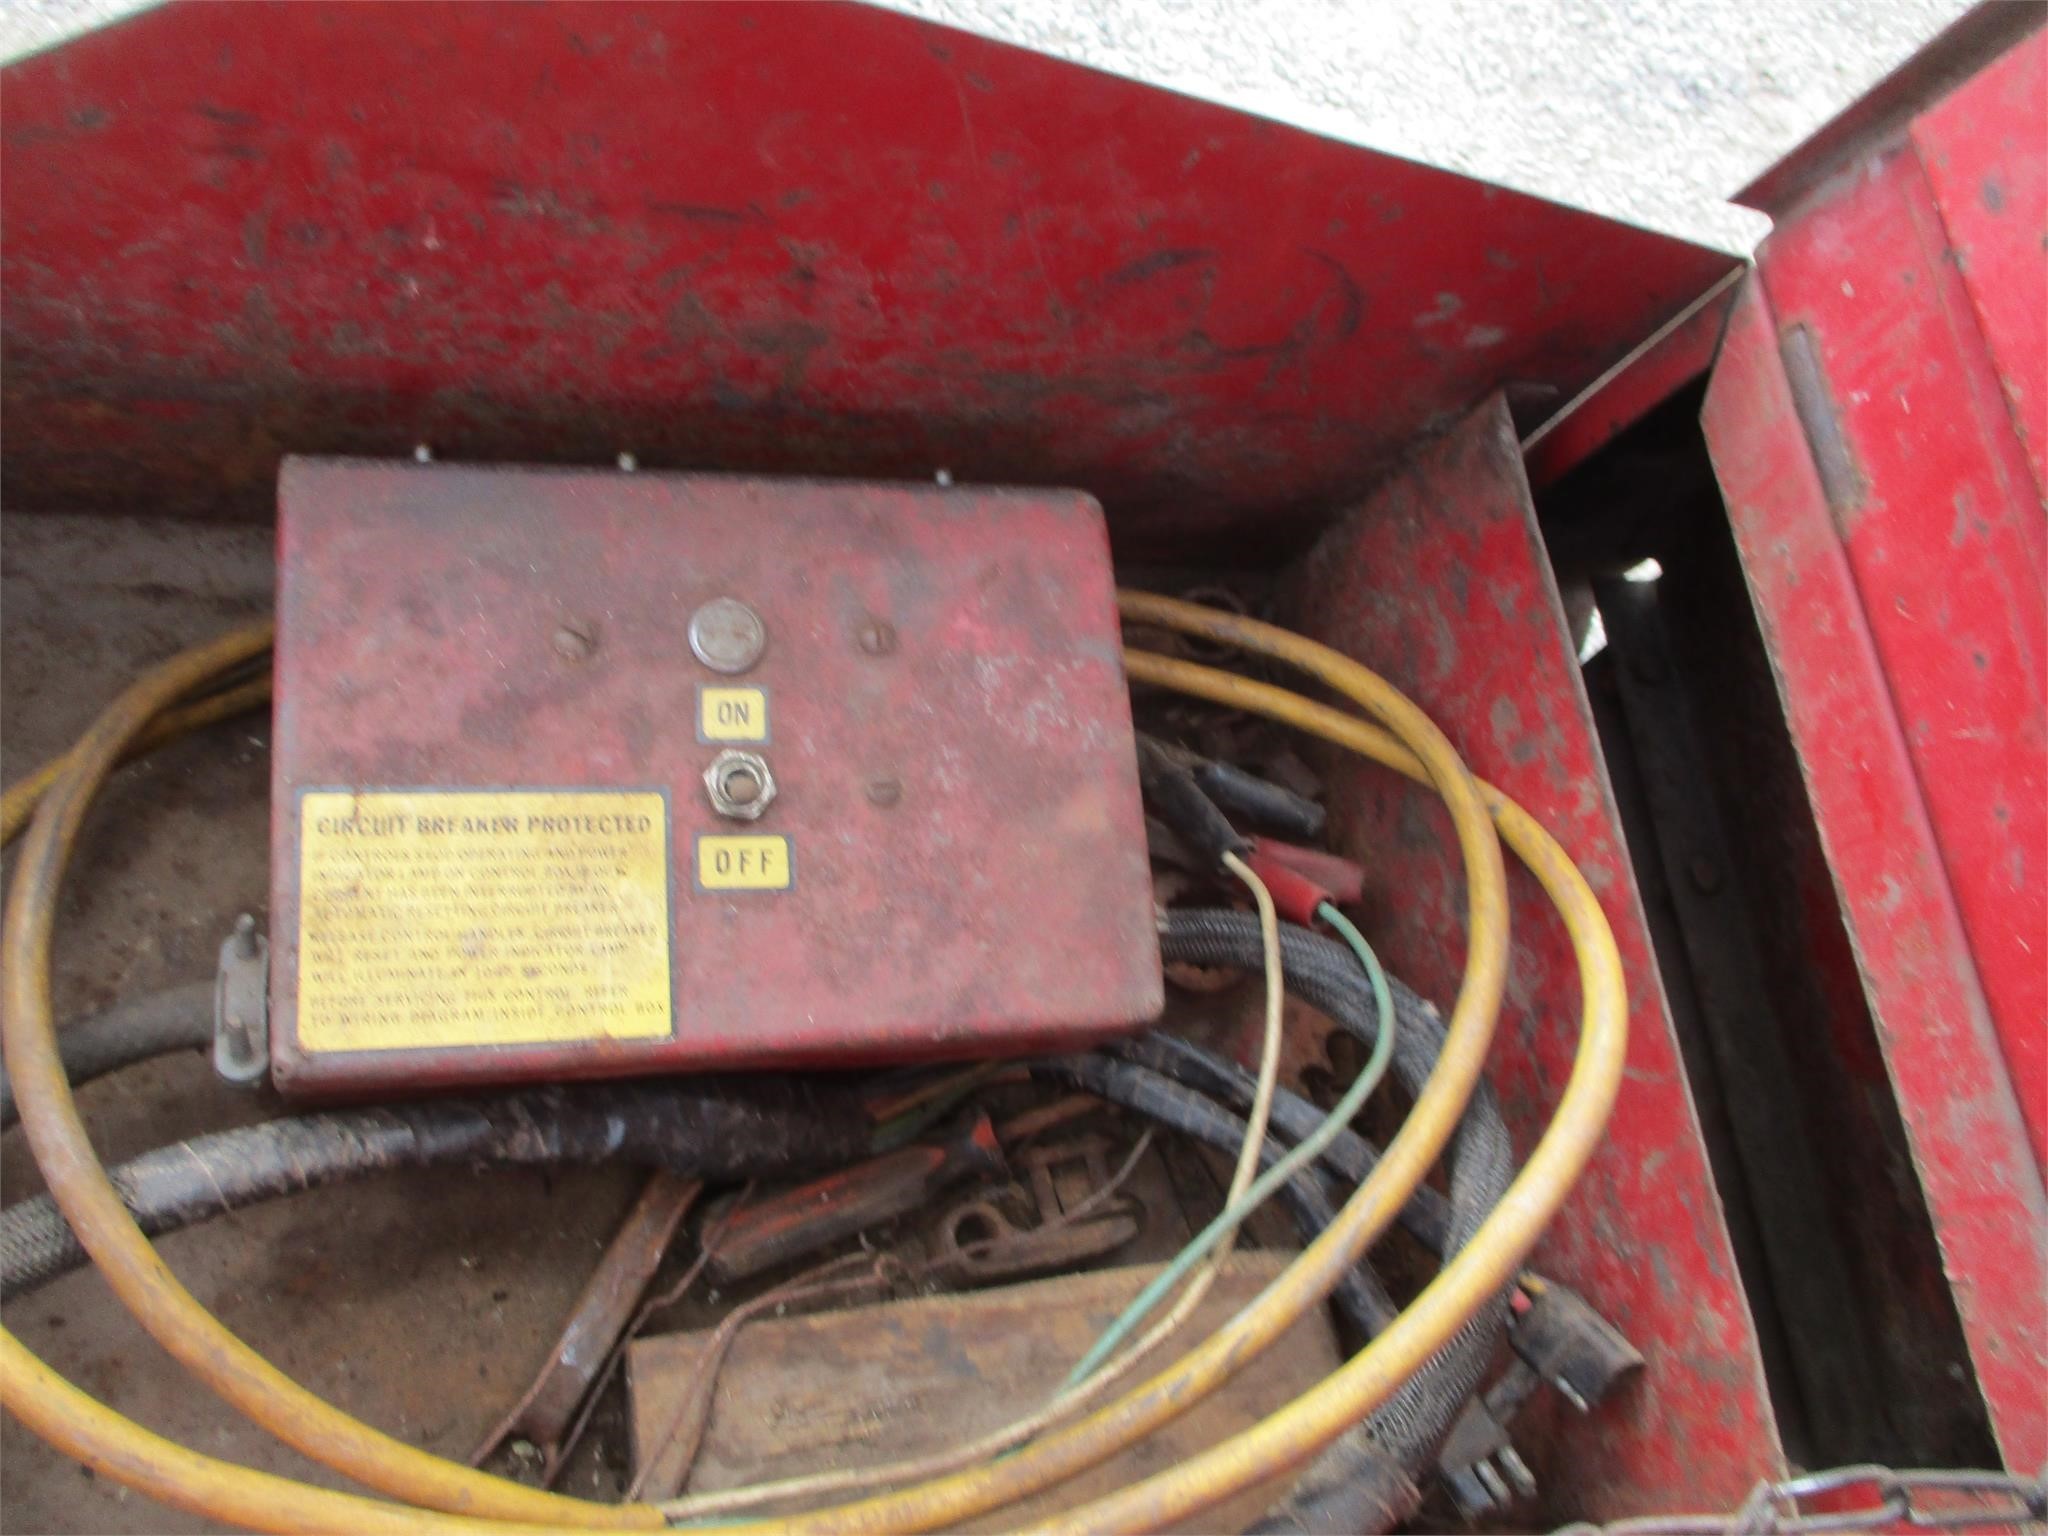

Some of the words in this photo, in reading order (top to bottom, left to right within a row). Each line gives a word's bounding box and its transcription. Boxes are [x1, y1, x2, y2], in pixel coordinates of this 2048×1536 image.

[717, 700, 750, 725] ON
[317, 816, 407, 837] CIRCUIT
[417, 815, 519, 836] BREAKER
[528, 814, 652, 835] PROTECTED
[715, 850, 774, 876] OFF
